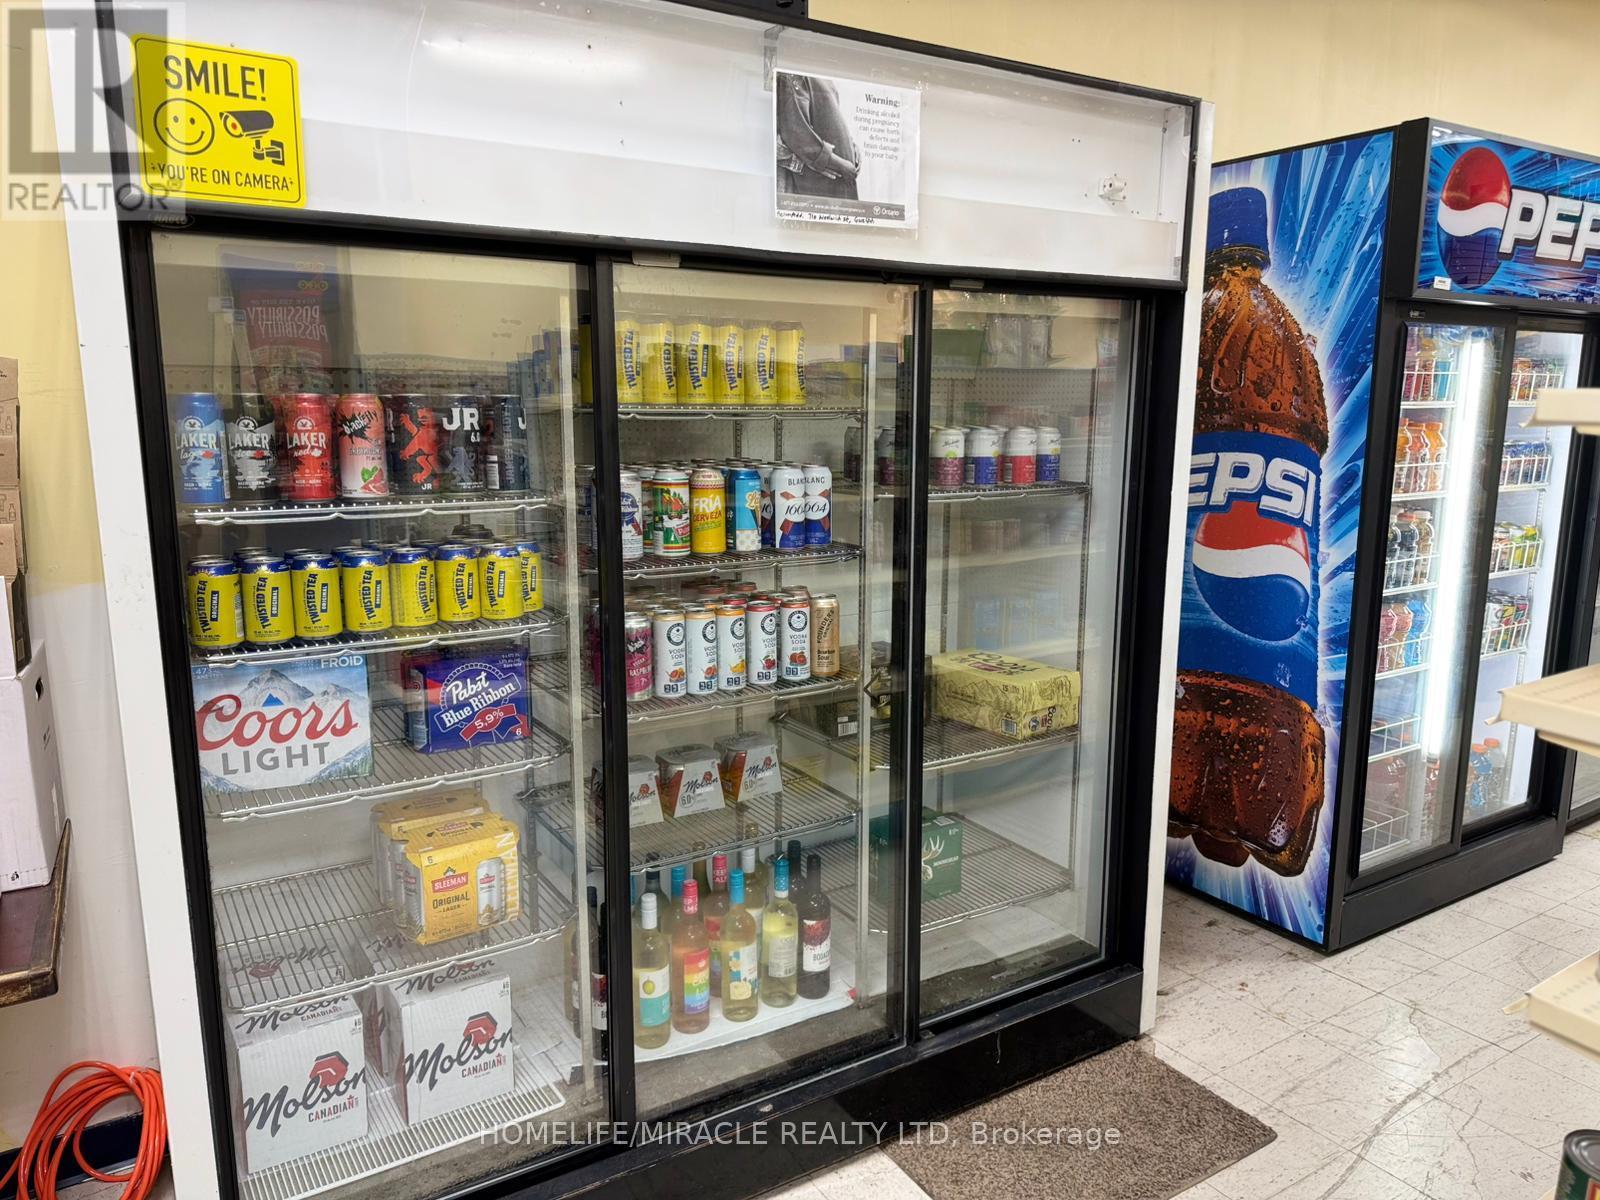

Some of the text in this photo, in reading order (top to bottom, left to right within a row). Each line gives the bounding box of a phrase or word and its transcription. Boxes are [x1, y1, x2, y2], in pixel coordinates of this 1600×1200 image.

[163, 54, 267, 102] SMILE!
[865, 93, 900, 108] Warning:
[158, 163, 290, 192] YOU'RE ON CAMERA
[442, 407, 480, 431] JR
[175, 432, 217, 450] LAKER
[229, 432, 269, 450] LAKER
[286, 432, 327, 449] LAKER
[362, 570, 377, 620] TWISTED TEA
[418, 565, 431, 614] TWISTED TEA
[455, 563, 468, 610] TWISTED TEA
[486, 561, 498, 608] TWISTED TEA
[521, 556, 532, 602] TWISTED TEA
[197, 580, 211, 633] TWISTED TEA
[256, 577, 272, 629] TWISTED TEA
[306, 573, 321, 624] TWISTED TEA
[321, 655, 364, 669] FROID
[441, 682, 516, 728] Blue Ribbon
[446, 671, 490, 704] Pabst
[196, 694, 359, 751] Coors
[221, 741, 331, 776] LIGHT
[432, 892, 470, 910] ORIGINAL
[434, 875, 467, 890] SLEEMAN
[395, 958, 495, 995] Molson
[404, 1027, 512, 1091] Molson
[462, 1056, 502, 1078] CANADIAN
[244, 1066, 366, 1138] Molson
[308, 1097, 354, 1122] CANADIAN
